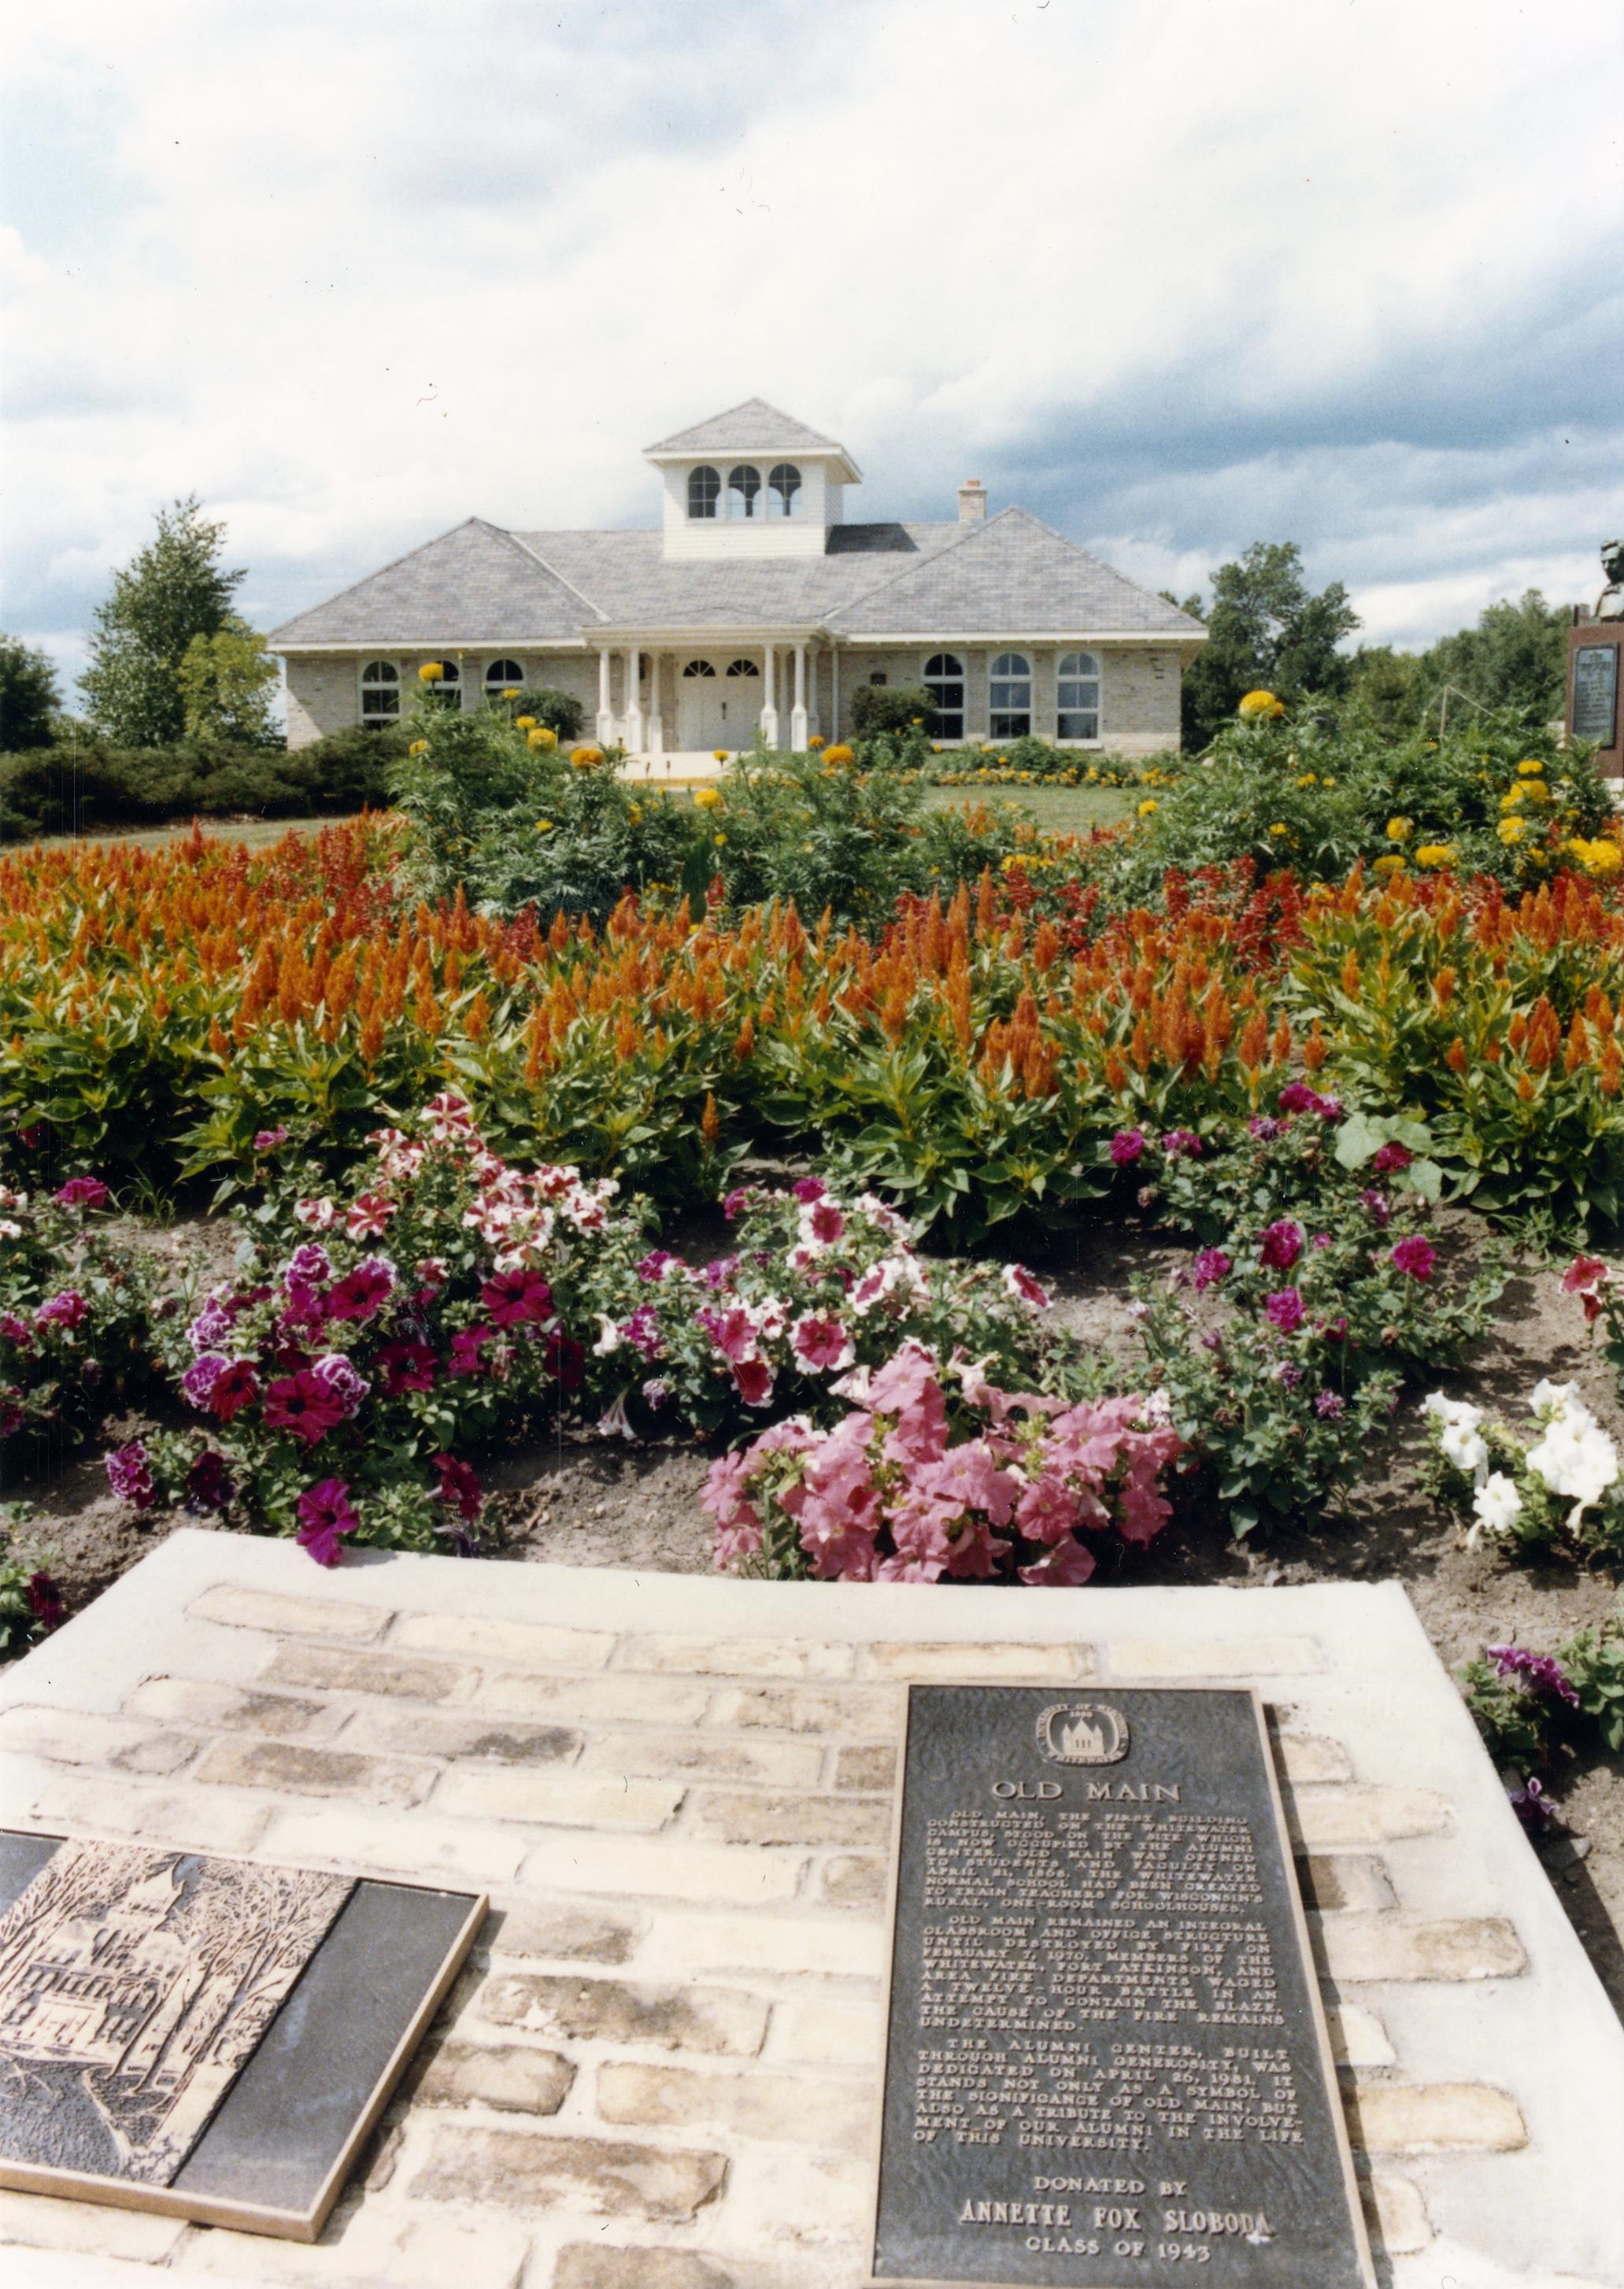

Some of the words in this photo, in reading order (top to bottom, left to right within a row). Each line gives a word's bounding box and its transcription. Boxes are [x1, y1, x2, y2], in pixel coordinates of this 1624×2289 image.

[990, 1780, 1063, 1799] OLD
[1085, 1781, 1180, 1801] MAIN
[926, 1818, 1044, 1829] CONSTRUCTED
[1057, 1821, 1080, 1830] ON
[1141, 1823, 1250, 1833] WHITEWATER
[950, 1810, 982, 1818] OLD
[994, 1810, 1045, 1820] MAIN,
[1103, 1814, 1152, 1822] FIRST
[1167, 1815, 1248, 1824] BUILDING
[926, 1836, 941, 1845] IS
[957, 1837, 993, 1847] NOW
[1006, 1838, 1088, 1848] OCCUPIED
[1138, 1842, 1171, 1851] THE
[1186, 1843, 1253, 1853] ALUMNI
[927, 1828, 994, 1838] CAMPUS,
[1004, 1830, 1054, 1839] STOOD
[1195, 1834, 1251, 1843] WHICH
[926, 1856, 948, 1866] TO
[965, 1856, 1059, 1868] STUDENTS
[1133, 1860, 1215, 1871] FACULTY
[1016, 1848, 1049, 1857] OLD
[1130, 1851, 1166, 1860] WAS
[1183, 1852, 1255, 1862] OPENED
[927, 1866, 974, 1876] APRIL
[1088, 1869, 1121, 1879] THE
[1138, 1871, 1258, 1882] WHITEWATER
[925, 1877, 993, 1886] NORMAL
[1006, 1878, 1068, 1888] SCHOOL
[1081, 1880, 1117, 1888] HAD
[1128, 1880, 1171, 1889] BEEN
[1184, 1883, 1261, 1891] CREATED
[923, 1887, 945, 1895] TO
[954, 1888, 1006, 1896] TRAIN
[1019, 1888, 1104, 1899] TEACHERS
[1115, 1890, 1148, 1900] FOR
[922, 1896, 989, 1908] RURAL,
[1109, 1900, 1245, 1913] SCHOOLHOUSES.
[949, 1915, 980, 1925] OLD
[990, 1916, 1035, 1925] MAIN
[1046, 1917, 1135, 1927] REMAINED
[1144, 1920, 1169, 1928] AN
[1178, 1921, 1267, 1931] INTEGRAL
[922, 1925, 1025, 1936] CLASSROOM
[1039, 1928, 1077, 1938] AND
[1089, 1929, 1150, 1940] OFFICE
[1162, 1930, 1268, 1942] STRUCTURE
[922, 1936, 982, 1947] UNTIL
[1004, 1938, 1117, 1950] DESTROYED
[1136, 1941, 1159, 1951] BY
[1180, 1942, 1225, 1952] FIRE
[1245, 1944, 1271, 1953] ON
[922, 1947, 1008, 1958] FEBRUARY
[1105, 1952, 1188, 1962] MEMBERS
[1202, 1954, 1223, 1963] OF
[1236, 1955, 1271, 1965] THE
[922, 1958, 1045, 1971] WHITEWATER,
[1056, 1961, 1103, 1971] FORT
[1118, 1962, 1222, 1975] ATKINSON,
[1235, 1966, 1275, 1976] AND
[920, 1969, 971, 1980] AREA
[990, 1972, 1033, 1981] FIRE
[1051, 1973, 1189, 1985] DEPARTMENTS
[1206, 1977, 1276, 1988] WAGED
[919, 1981, 932, 1991] A
[1119, 1986, 1194, 1997] BATTLE
[1212, 1988, 1234, 1999] IN
[1251, 1991, 1278, 1999] AN
[919, 1992, 1007, 2004] ATTEMPT
[1024, 1995, 1047, 2006] TO
[1063, 1997, 1146, 2007] CONTAIN
[1161, 1999, 1198, 2010] THE
[1214, 2001, 1282, 2011] BLAZE.
[919, 2005, 956, 2017] THE
[972, 2006, 1028, 2017] CAUSE
[1042, 2008, 1066, 2018] OF
[1078, 2009, 1116, 2020] THE
[1132, 2010, 1177, 2022] FIRE
[1194, 2012, 1285, 2025] REMAINS
[919, 2017, 1083, 2032] UNDETERMINED.
[947, 2039, 986, 2049] THE
[1008, 2039, 1090, 2055] ALUMNI
[1110, 2043, 1202, 2058] CENTER,
[1222, 2047, 1288, 2060] BUILT
[916, 2049, 1006, 2062] THROUGH
[1023, 2053, 1097, 2065] ALUMNI
[1112, 2056, 1239, 2073] GENEROSITY,
[1251, 2062, 1292, 2072] WAS
[917, 2062, 1033, 2077] DEDICATED
[1049, 2067, 1075, 2076] ON
[1093, 2069, 1155, 2080] APRIL
[1171, 2071, 1200, 2084] 26,
[1272, 2076, 1293, 2086] IT
[915, 2076, 986, 2087] STANDS
[1002, 2079, 1039, 2089] NOT
[1056, 2081, 1104, 2091] ONLY
[1117, 2083, 1142, 2094] AS
[1159, 2084, 1172, 2095] A
[1186, 2085, 1260, 2099] SYMBOL
[1273, 2089, 1297, 2100] OF
[916, 2089, 953, 2101] THE
[967, 2090, 1097, 2106] SIGNIFICANCE
[1108, 2095, 1132, 2106] OF
[1142, 2097, 1181, 2109] OLD
[1193, 2099, 1251, 2113] MAIN,
[1261, 2102, 1299, 2114] BUT
[915, 2102, 964, 2113] ALSO
[975, 2104, 998, 2115] AS
[1011, 2106, 1024, 2117] A
[1034, 2106, 1111, 2120] TRIBUTE
[1123, 2110, 1145, 2121] TO
[1156, 2111, 1196, 2124] THE
[1208, 2113, 1304, 2128] INVOLVE-
[914, 2116, 970, 2132] MENT
[984, 2119, 1007, 2130] OF
[1019, 2120, 1059, 2132] OUR
[1074, 2122, 1152, 2137] ALUMNI
[1166, 2125, 1189, 2139] IN
[1201, 2127, 1244, 2142] THE
[1258, 2129, 1304, 2143] LIFE
[912, 2130, 936, 2142] OF
[953, 2131, 1000, 2147] THIS
[1017, 2133, 1149, 2152] UNIVERSITY.
[1032, 2175, 1145, 2194] DONATED
[1160, 2181, 1187, 2196] BY
[960, 2198, 1071, 2227] ANNETTE
[1092, 2206, 1141, 2230] FOX
[1164, 2209, 1274, 2236] SLOBODA
[1024, 2236, 1099, 2255] CLASS
[1112, 2239, 1145, 2257] OF
[1156, 2242, 1211, 2263] 1943
